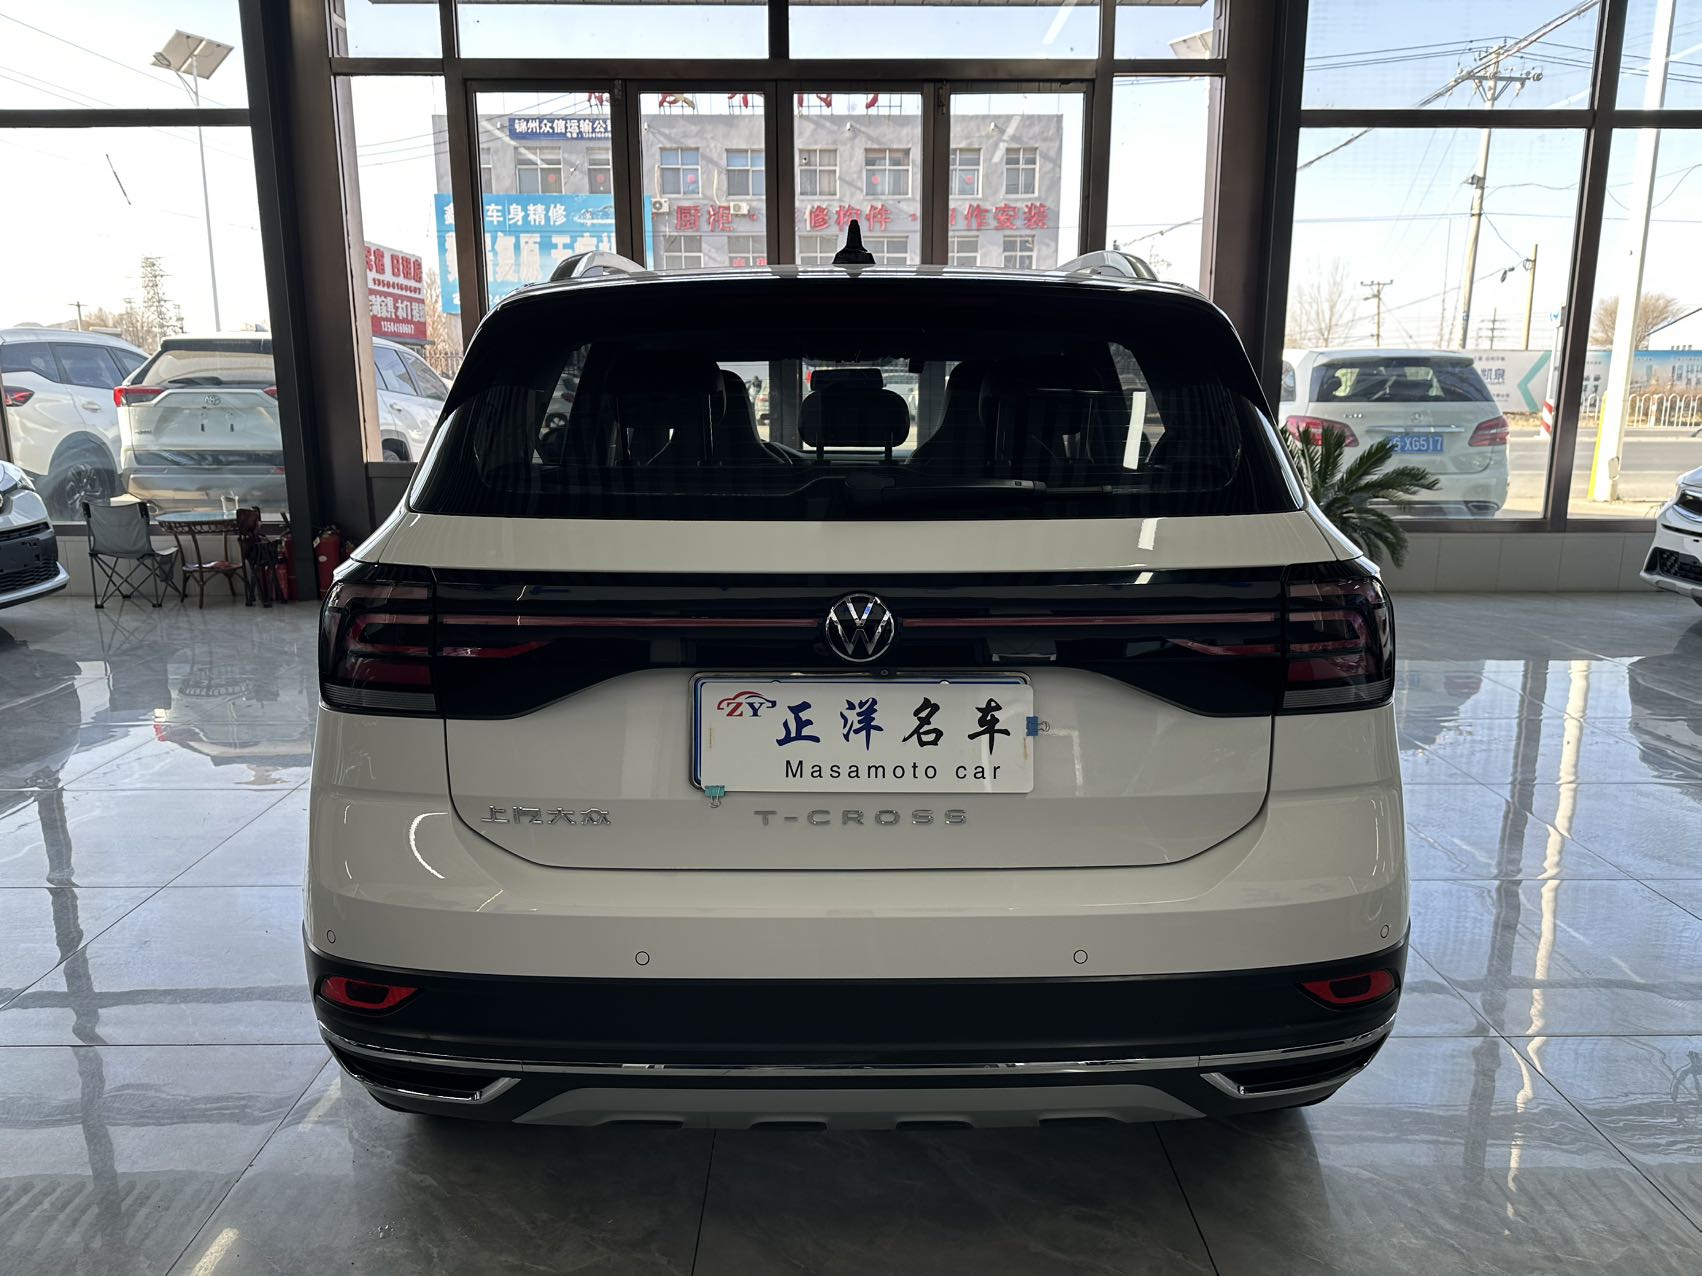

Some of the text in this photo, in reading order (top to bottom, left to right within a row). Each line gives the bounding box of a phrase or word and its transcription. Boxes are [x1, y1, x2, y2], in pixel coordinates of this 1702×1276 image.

[950, 203, 1048, 230] 作安装
[776, 697, 1011, 756] 正洋名车
[785, 760, 1001, 780] Masamoto car
[481, 805, 611, 825] 上汽大众
[753, 809, 968, 826] T-CROSS
